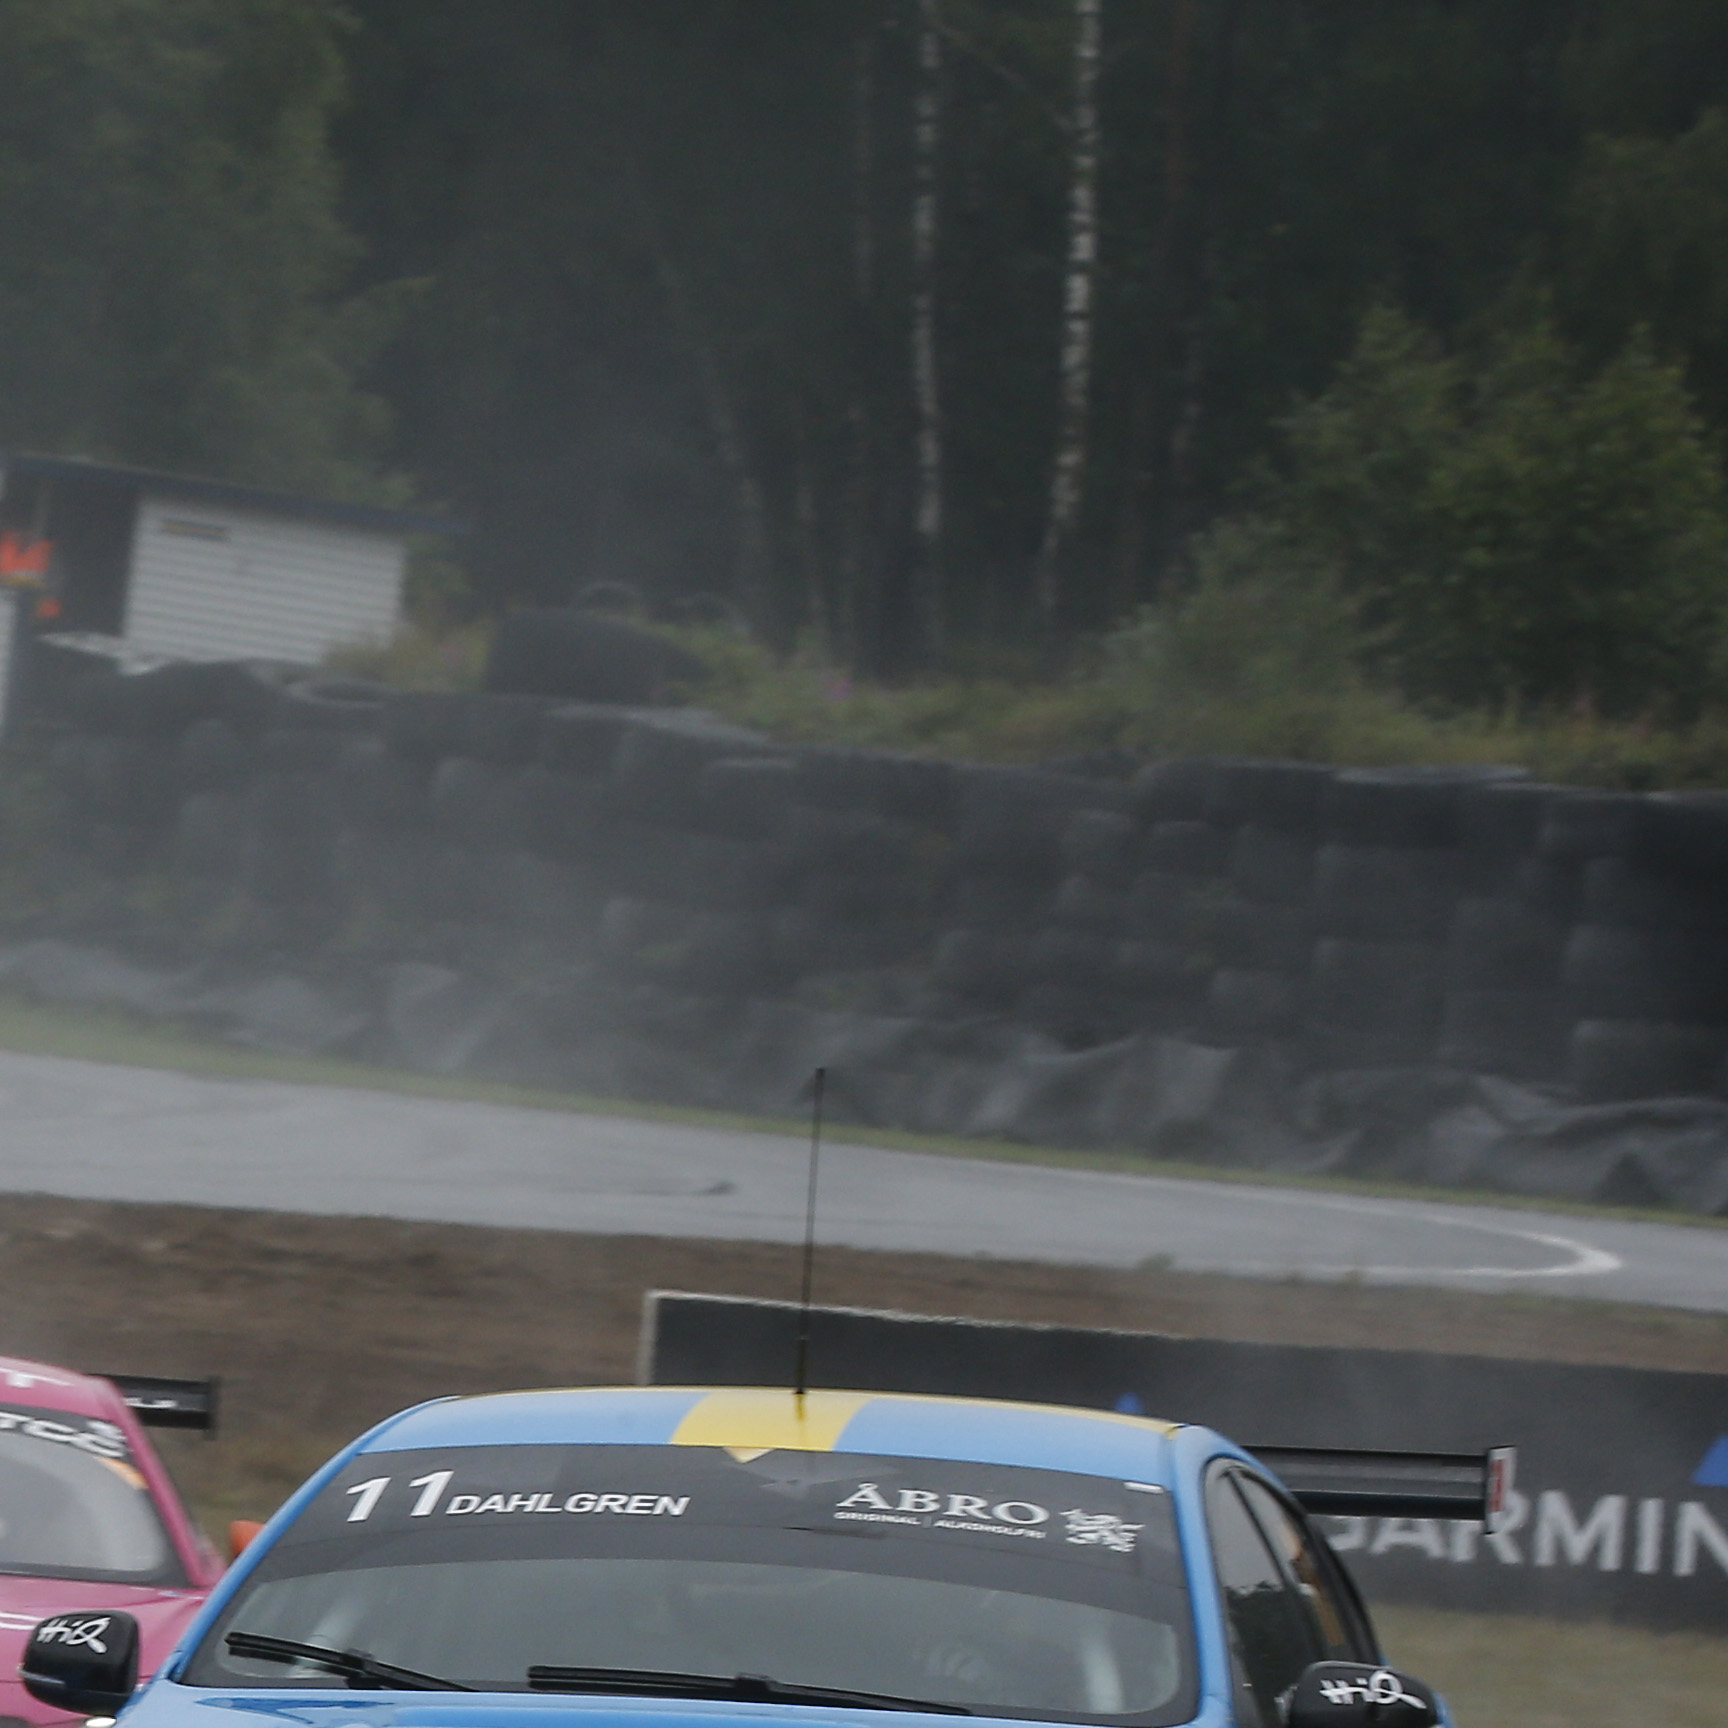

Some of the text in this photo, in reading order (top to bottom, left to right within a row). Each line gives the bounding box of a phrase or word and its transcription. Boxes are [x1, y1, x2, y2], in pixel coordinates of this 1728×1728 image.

[346, 1470, 691, 1522] 11 DAHLGREN
[836, 1482, 1051, 1526] ÅBRO
[1327, 1489, 1728, 1577] ARMIN
